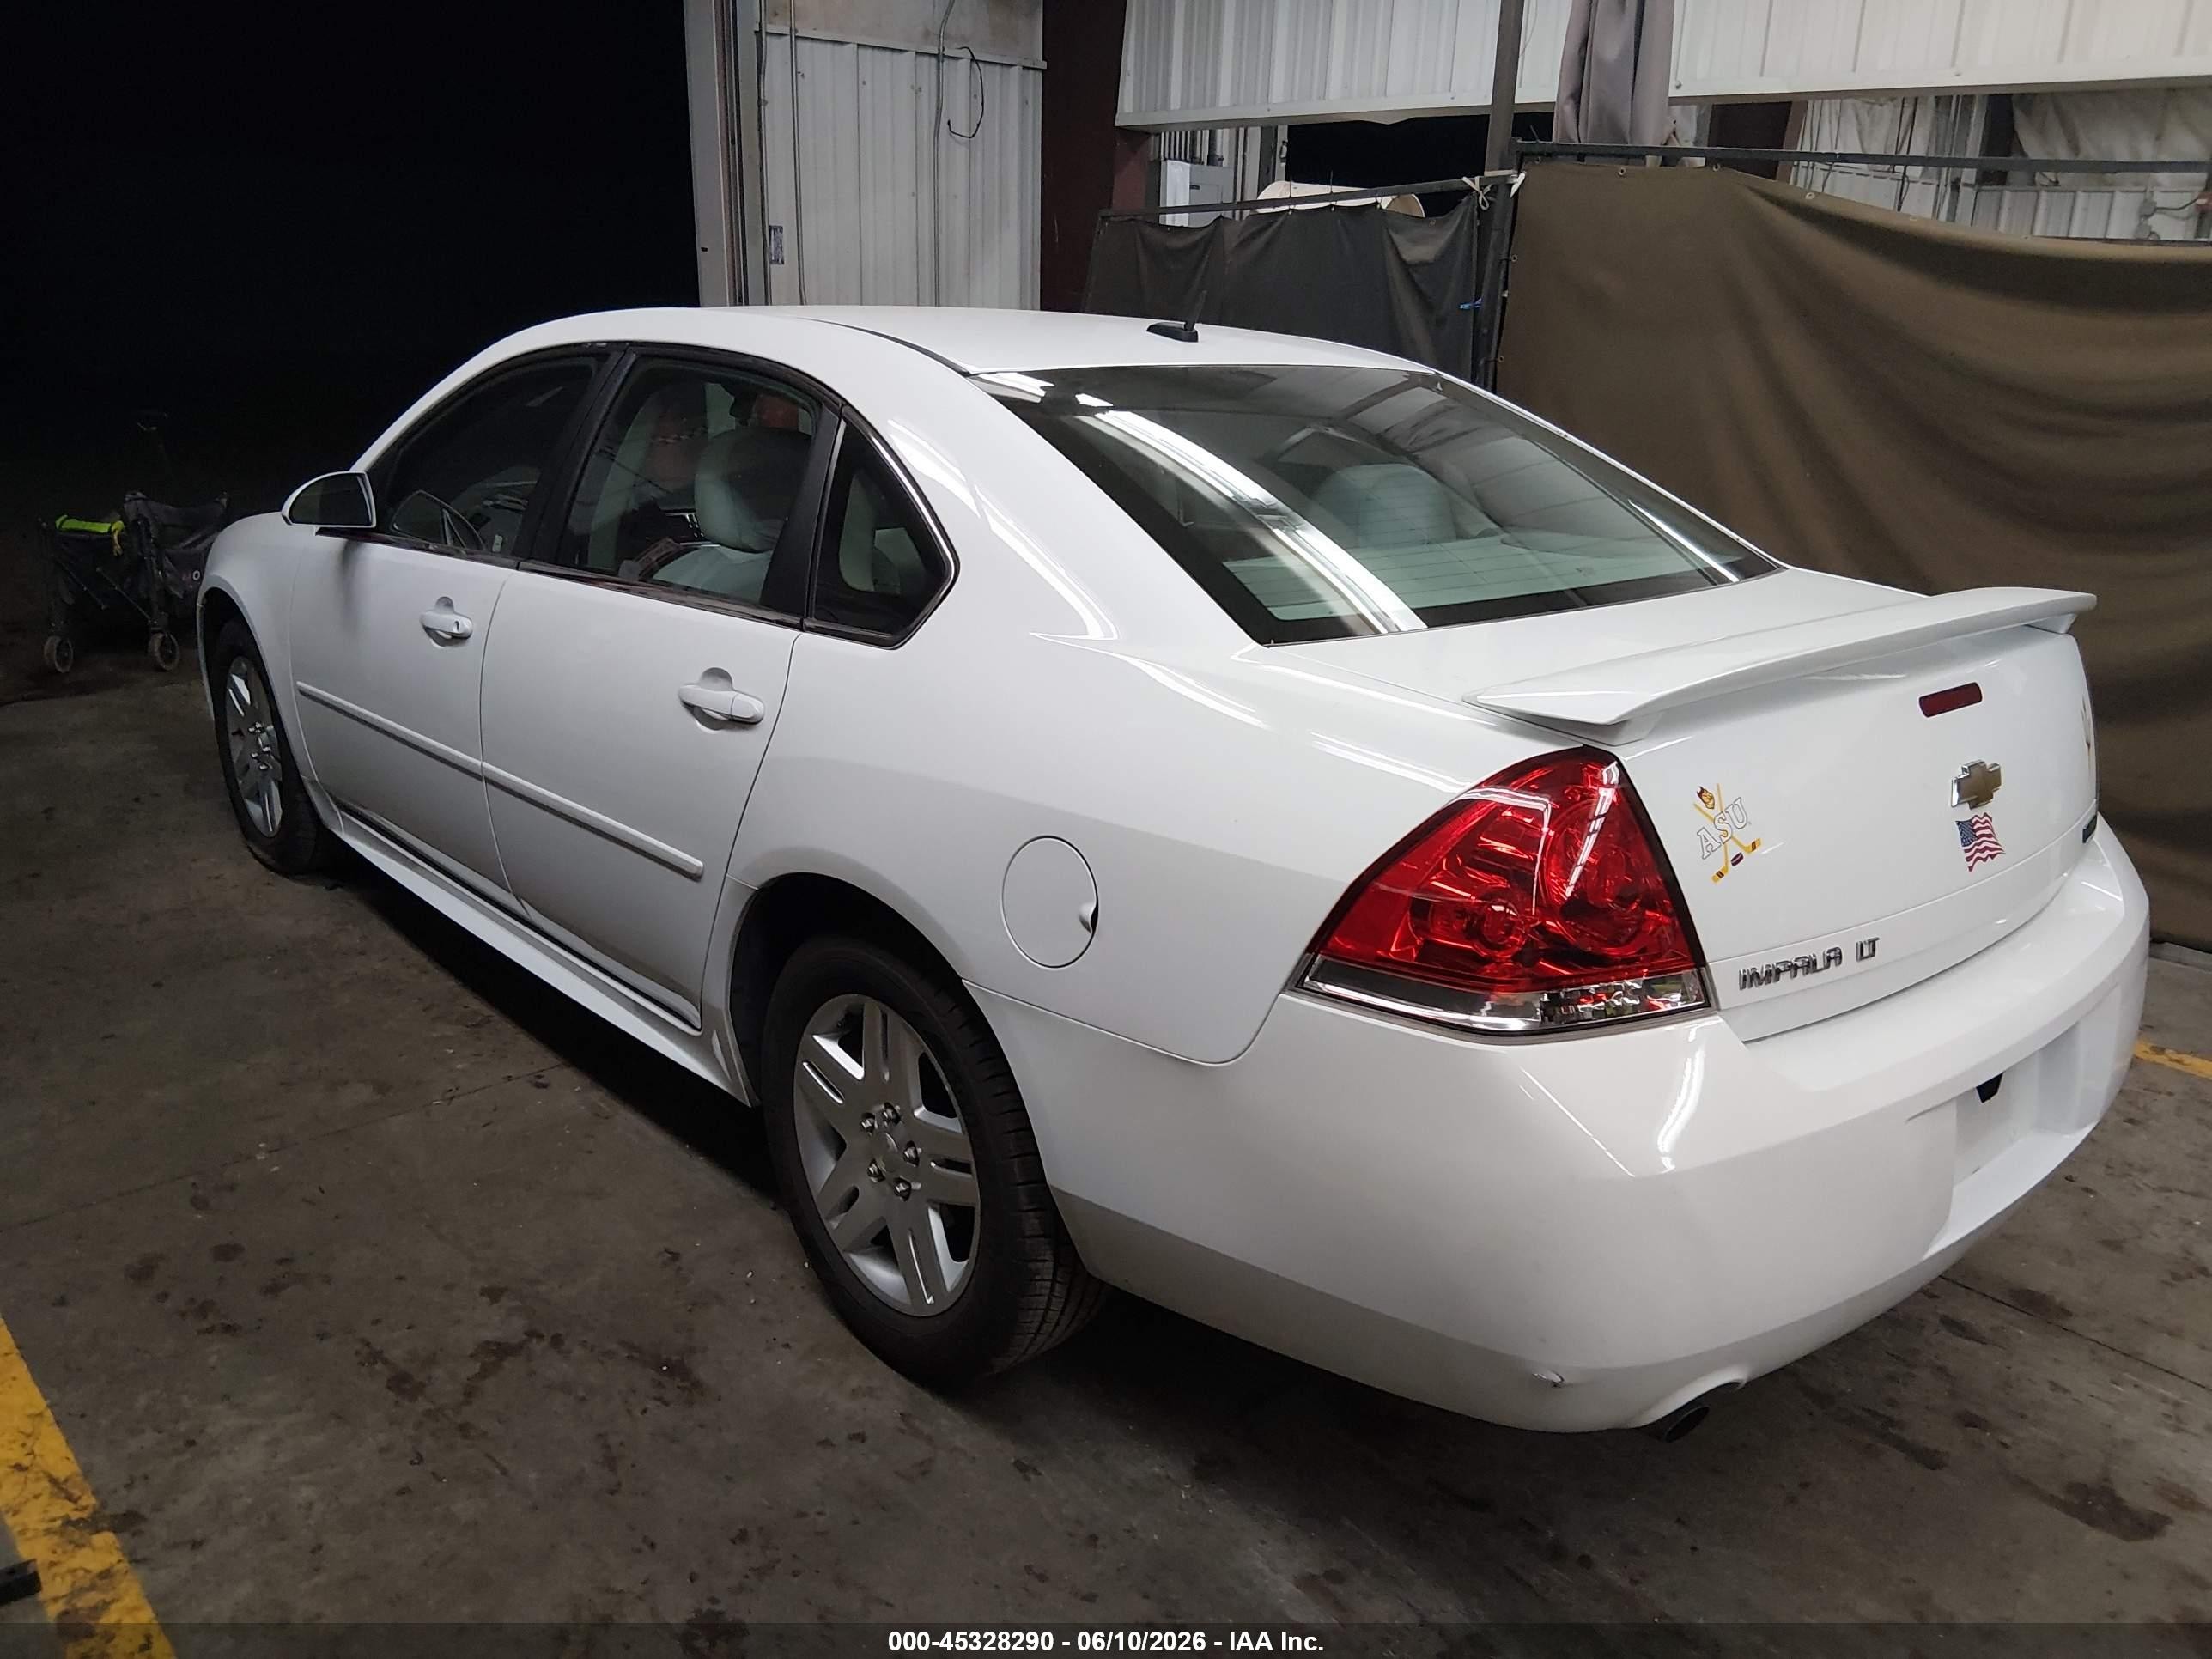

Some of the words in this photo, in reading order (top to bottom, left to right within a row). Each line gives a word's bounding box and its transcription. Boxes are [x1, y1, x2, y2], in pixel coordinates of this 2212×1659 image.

[1696, 796, 1749, 860] ASU
[1738, 946, 1843, 991] IMPALA
[1856, 937, 1880, 962] LT
